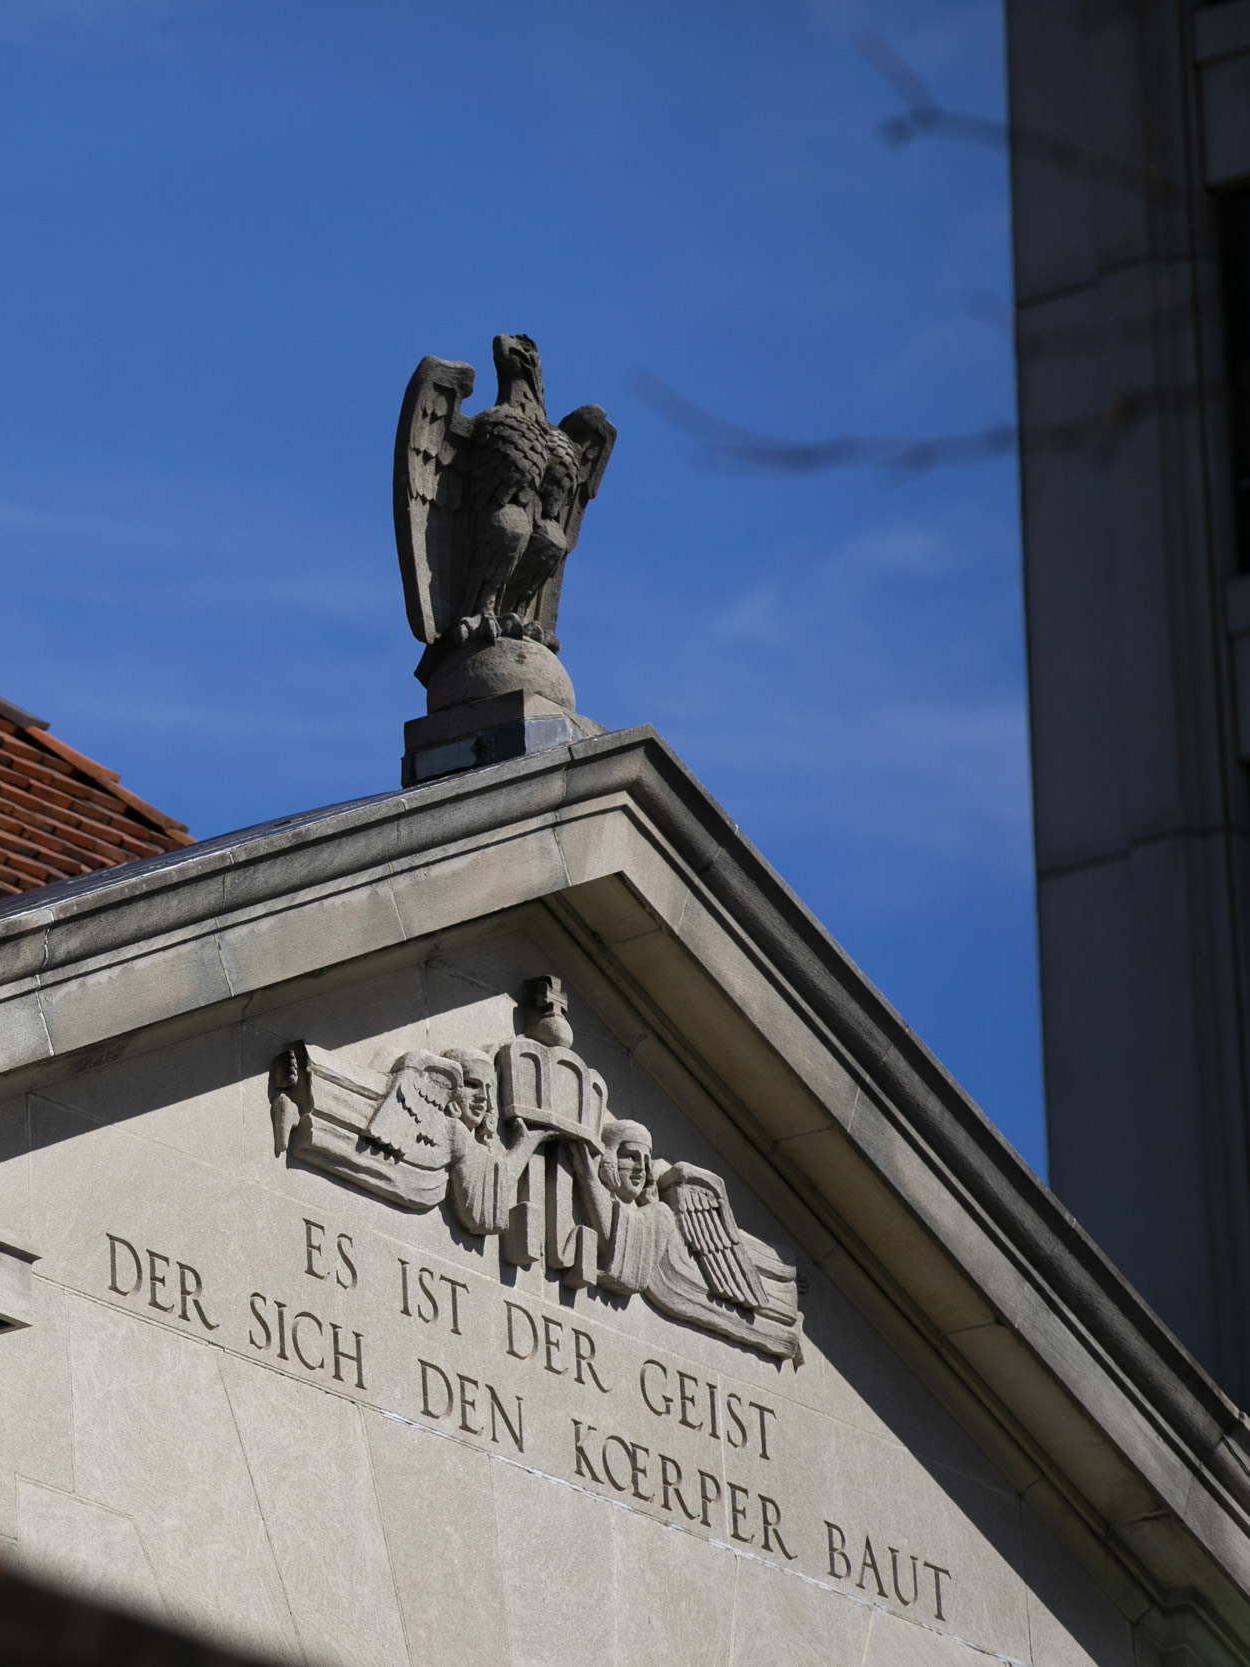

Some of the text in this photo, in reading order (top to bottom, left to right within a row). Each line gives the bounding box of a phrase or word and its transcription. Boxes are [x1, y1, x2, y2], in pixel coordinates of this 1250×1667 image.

[106, 1232, 219, 1331] DER
[249, 1292, 367, 1390] SICH
[417, 1358, 524, 1453] DEN
[824, 1520, 951, 1621] BAUT
[303, 1217, 776, 1460] ES IST DER GEIST
